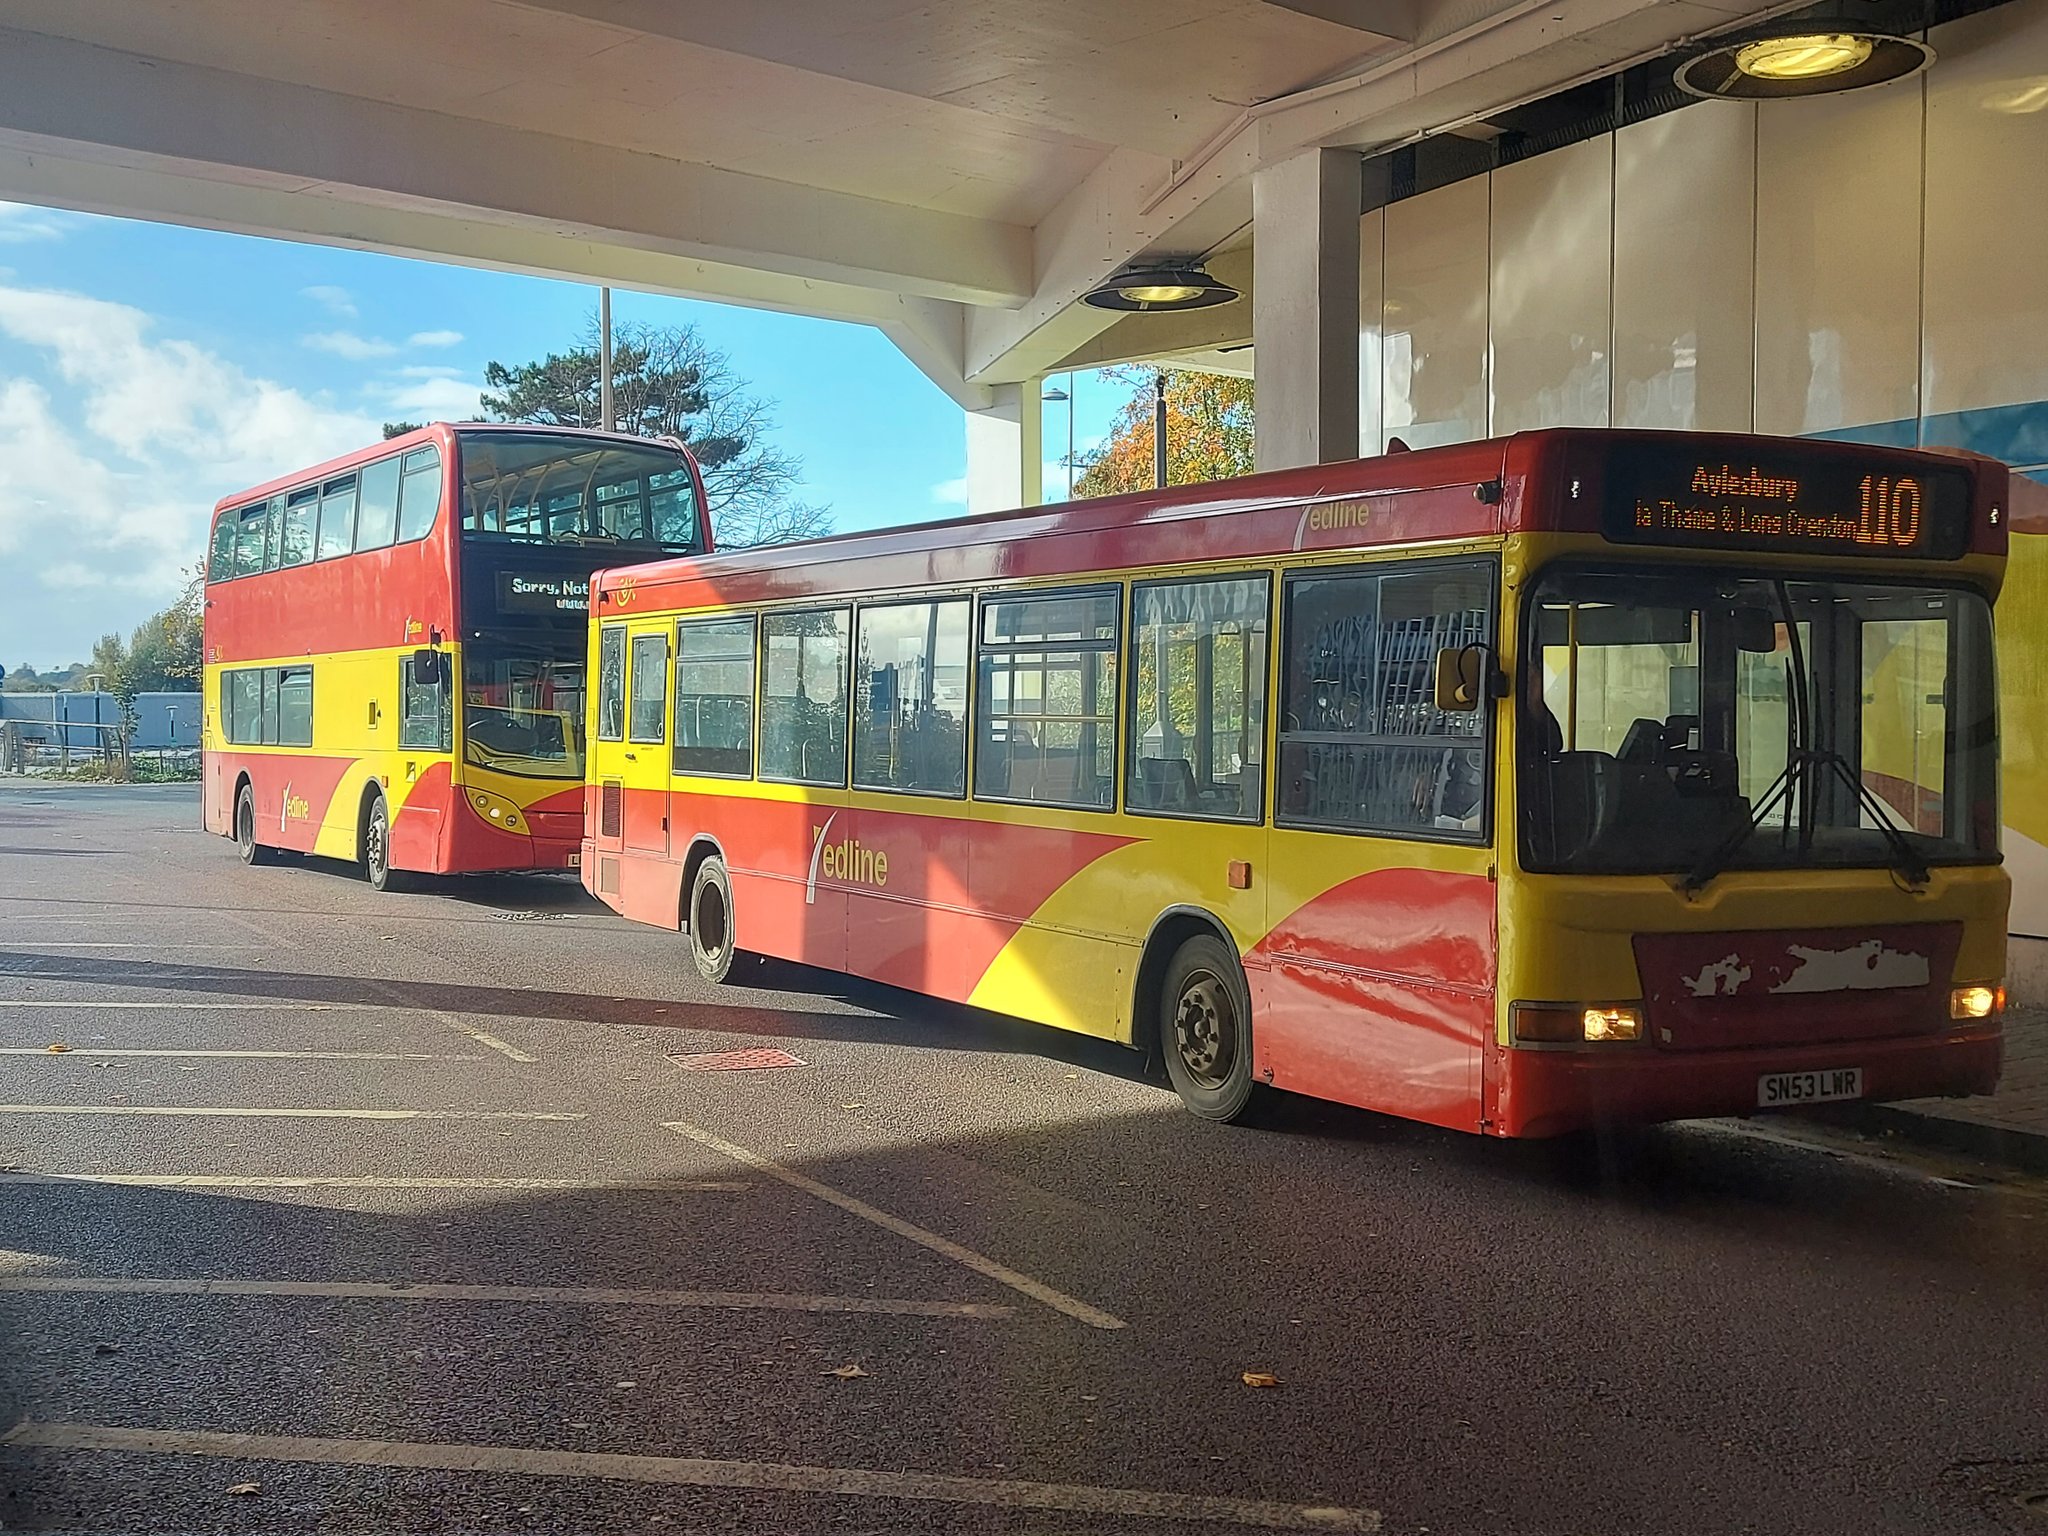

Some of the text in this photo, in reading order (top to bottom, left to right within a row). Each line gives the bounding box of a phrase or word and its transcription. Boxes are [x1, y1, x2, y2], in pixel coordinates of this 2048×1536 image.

[1691, 464, 1797, 502] Aylesbury
[1856, 475, 1921, 546] 110
[511, 577, 589, 596] Sorry, Not
[1766, 1071, 1856, 1101] SN53 LWR
